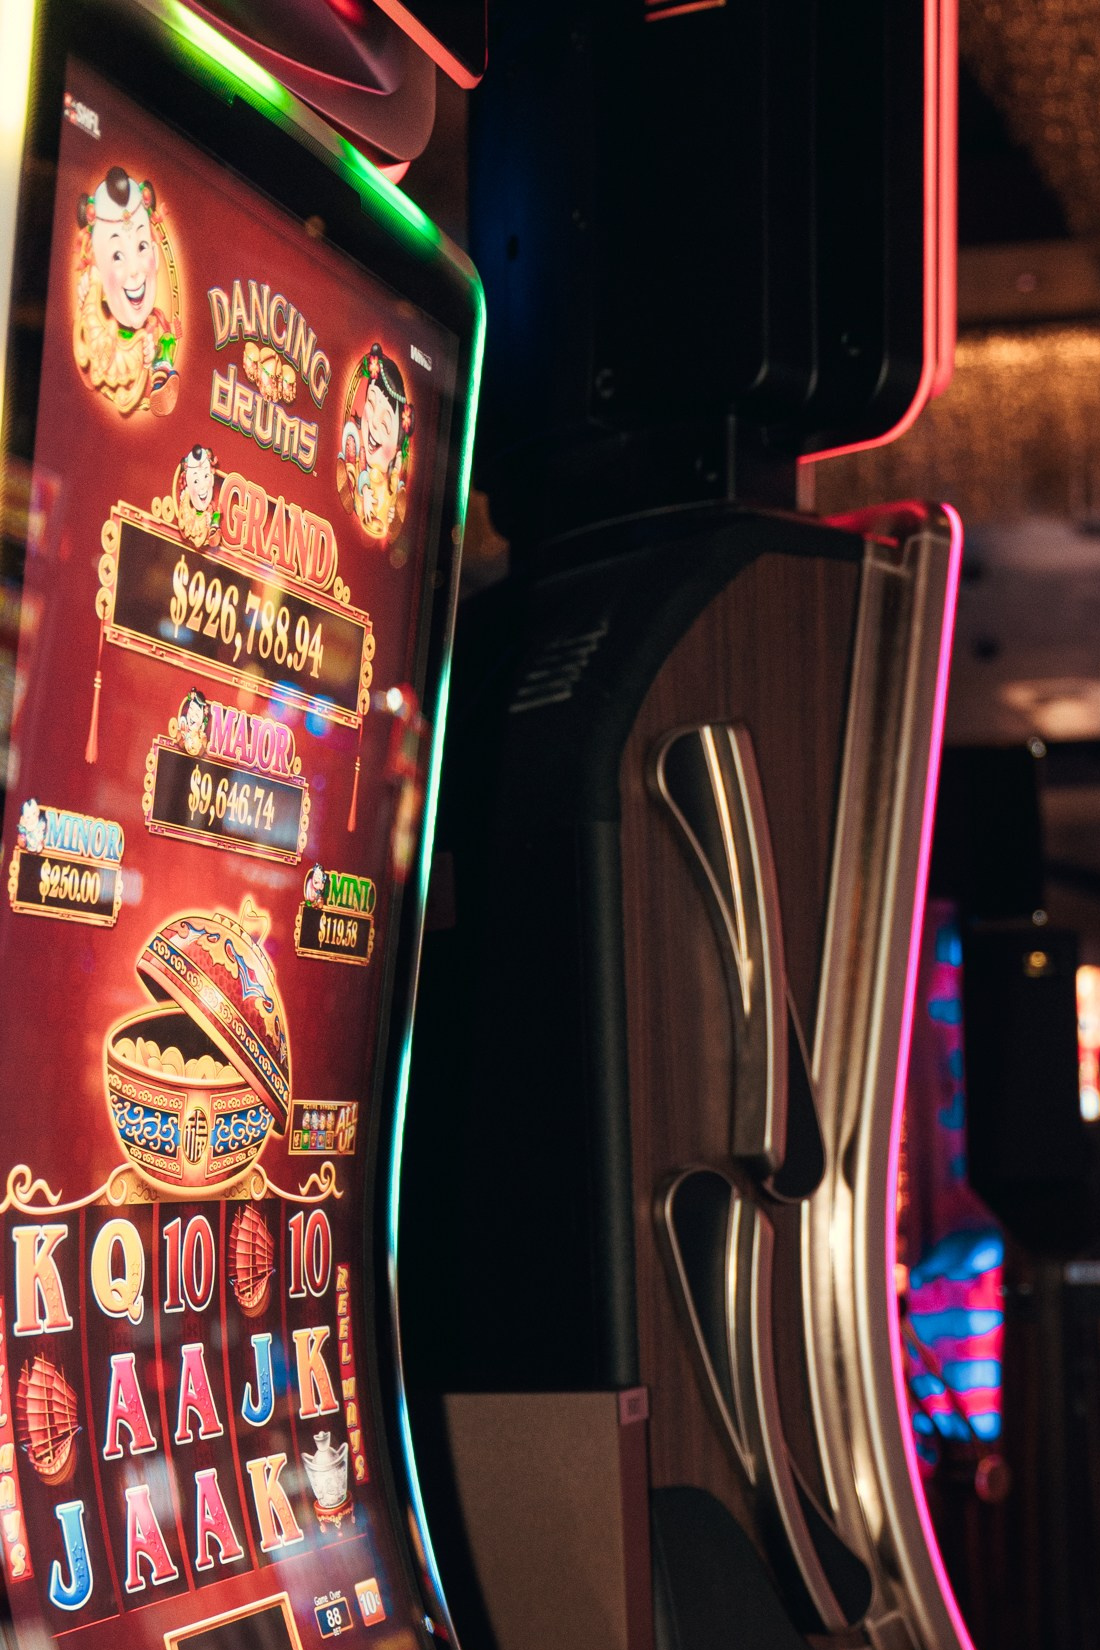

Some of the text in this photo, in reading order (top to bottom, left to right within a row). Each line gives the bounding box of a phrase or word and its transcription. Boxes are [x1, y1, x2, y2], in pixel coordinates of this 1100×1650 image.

[208, 279, 331, 409] DANCING
[219, 472, 336, 588] GRAND
[170, 554, 324, 678] $226,788.94
[207, 703, 290, 777] MAJOR
[188, 764, 275, 831] $9,646.74
[45, 808, 121, 862] MINOR
[39, 858, 101, 905] $250.00
[327, 871, 372, 912] MINI
[318, 912, 358, 948] $119.58
[335, 1103, 357, 1136] ALL
[338, 1125, 355, 1152] UP
[12, 1209, 332, 1337] K Q 10 10
[103, 1352, 157, 1460] A
[174, 1343, 224, 1445] A
[241, 1333, 273, 1427] J
[293, 1326, 339, 1419] K
[49, 1453, 304, 1611] J A A K
[314, 1590, 341, 1606] Game Over
[326, 1607, 342, 1628] 88
[333, 1627, 342, 1636] BET
